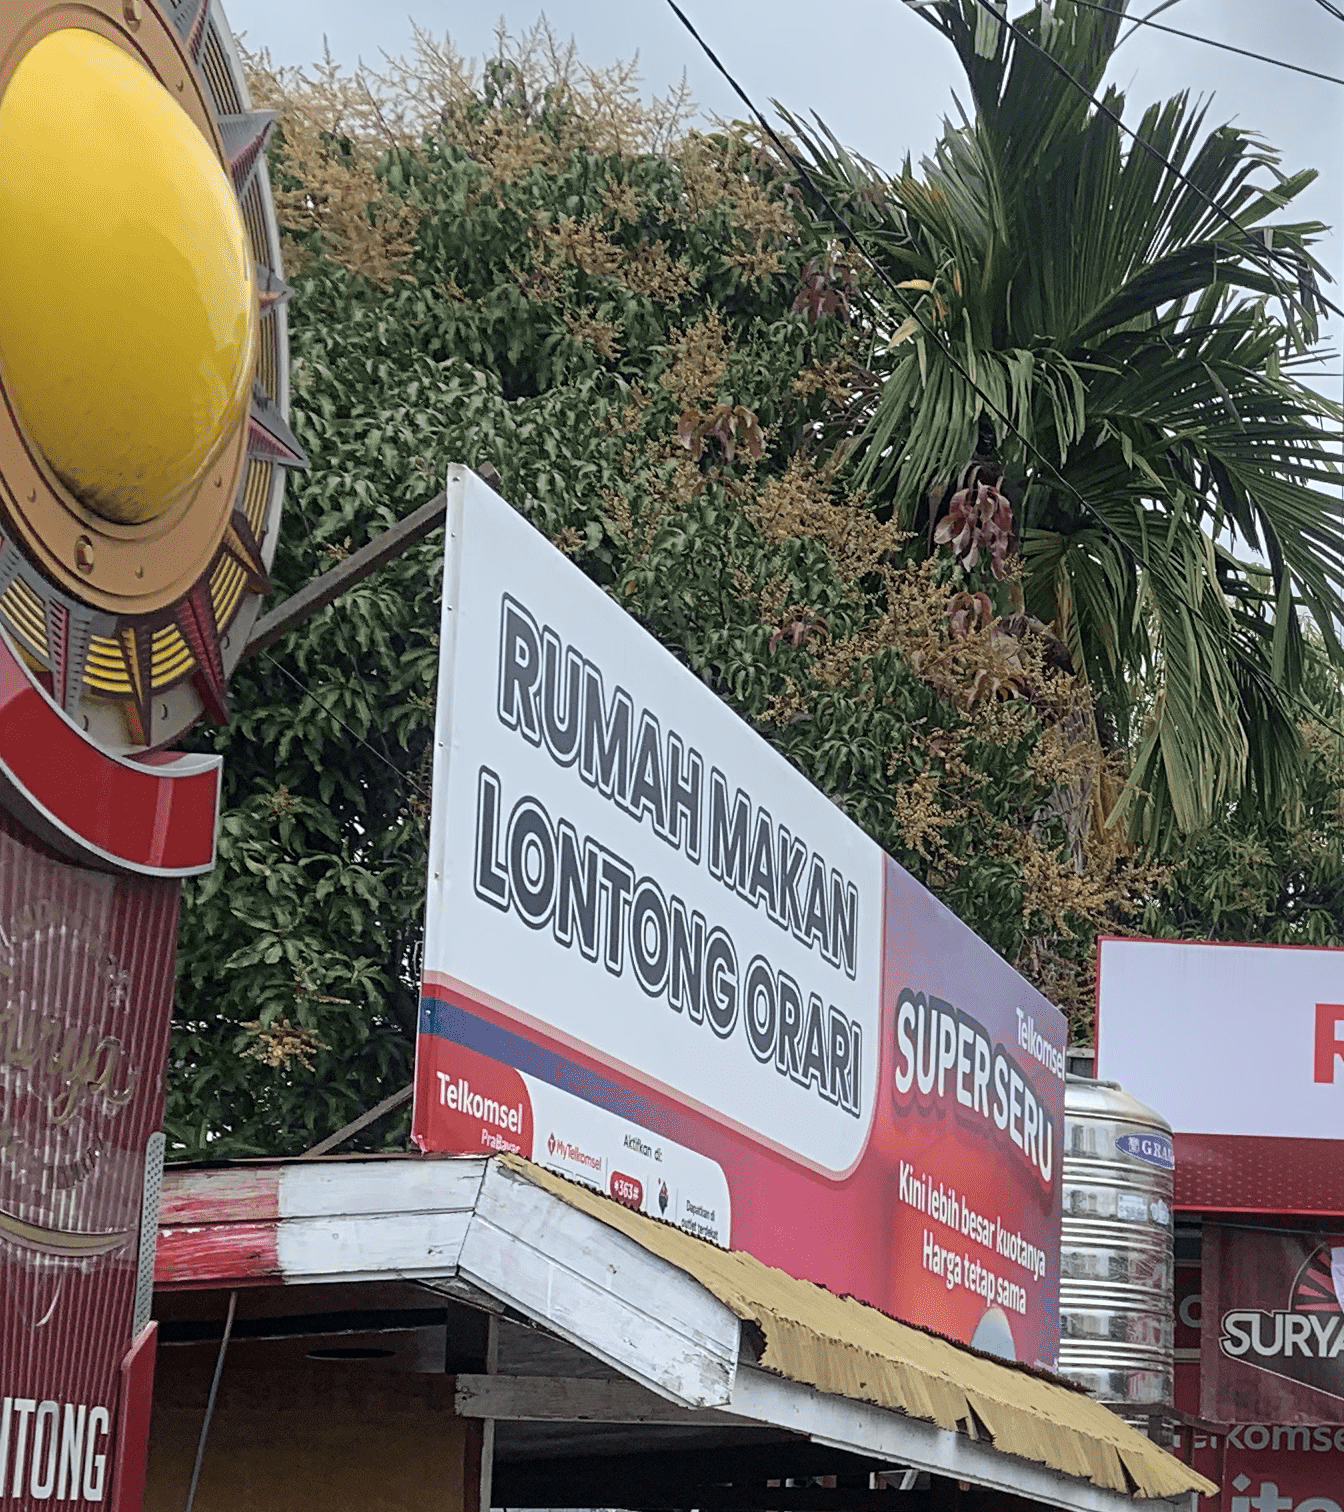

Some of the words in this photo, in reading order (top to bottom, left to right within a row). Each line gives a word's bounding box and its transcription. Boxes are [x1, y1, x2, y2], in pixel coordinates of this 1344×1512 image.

[498, 594, 703, 862] RUMAH
[709, 765, 859, 980] MAKAN
[475, 766, 738, 1040] LONTONG
[744, 955, 862, 1118] ORARI
[1016, 1007, 1066, 1081] Telkomsel
[437, 1071, 523, 1134] Telkomsel
[899, 1159, 926, 1213] Kini
[928, 1175, 959, 1231] lebih
[961, 1195, 995, 1250] besar
[996, 1216, 1046, 1282] kuotanya
[923, 1228, 962, 1290] Harga
[964, 1253, 995, 1307] tetap
[996, 1277, 1027, 1315] sama
